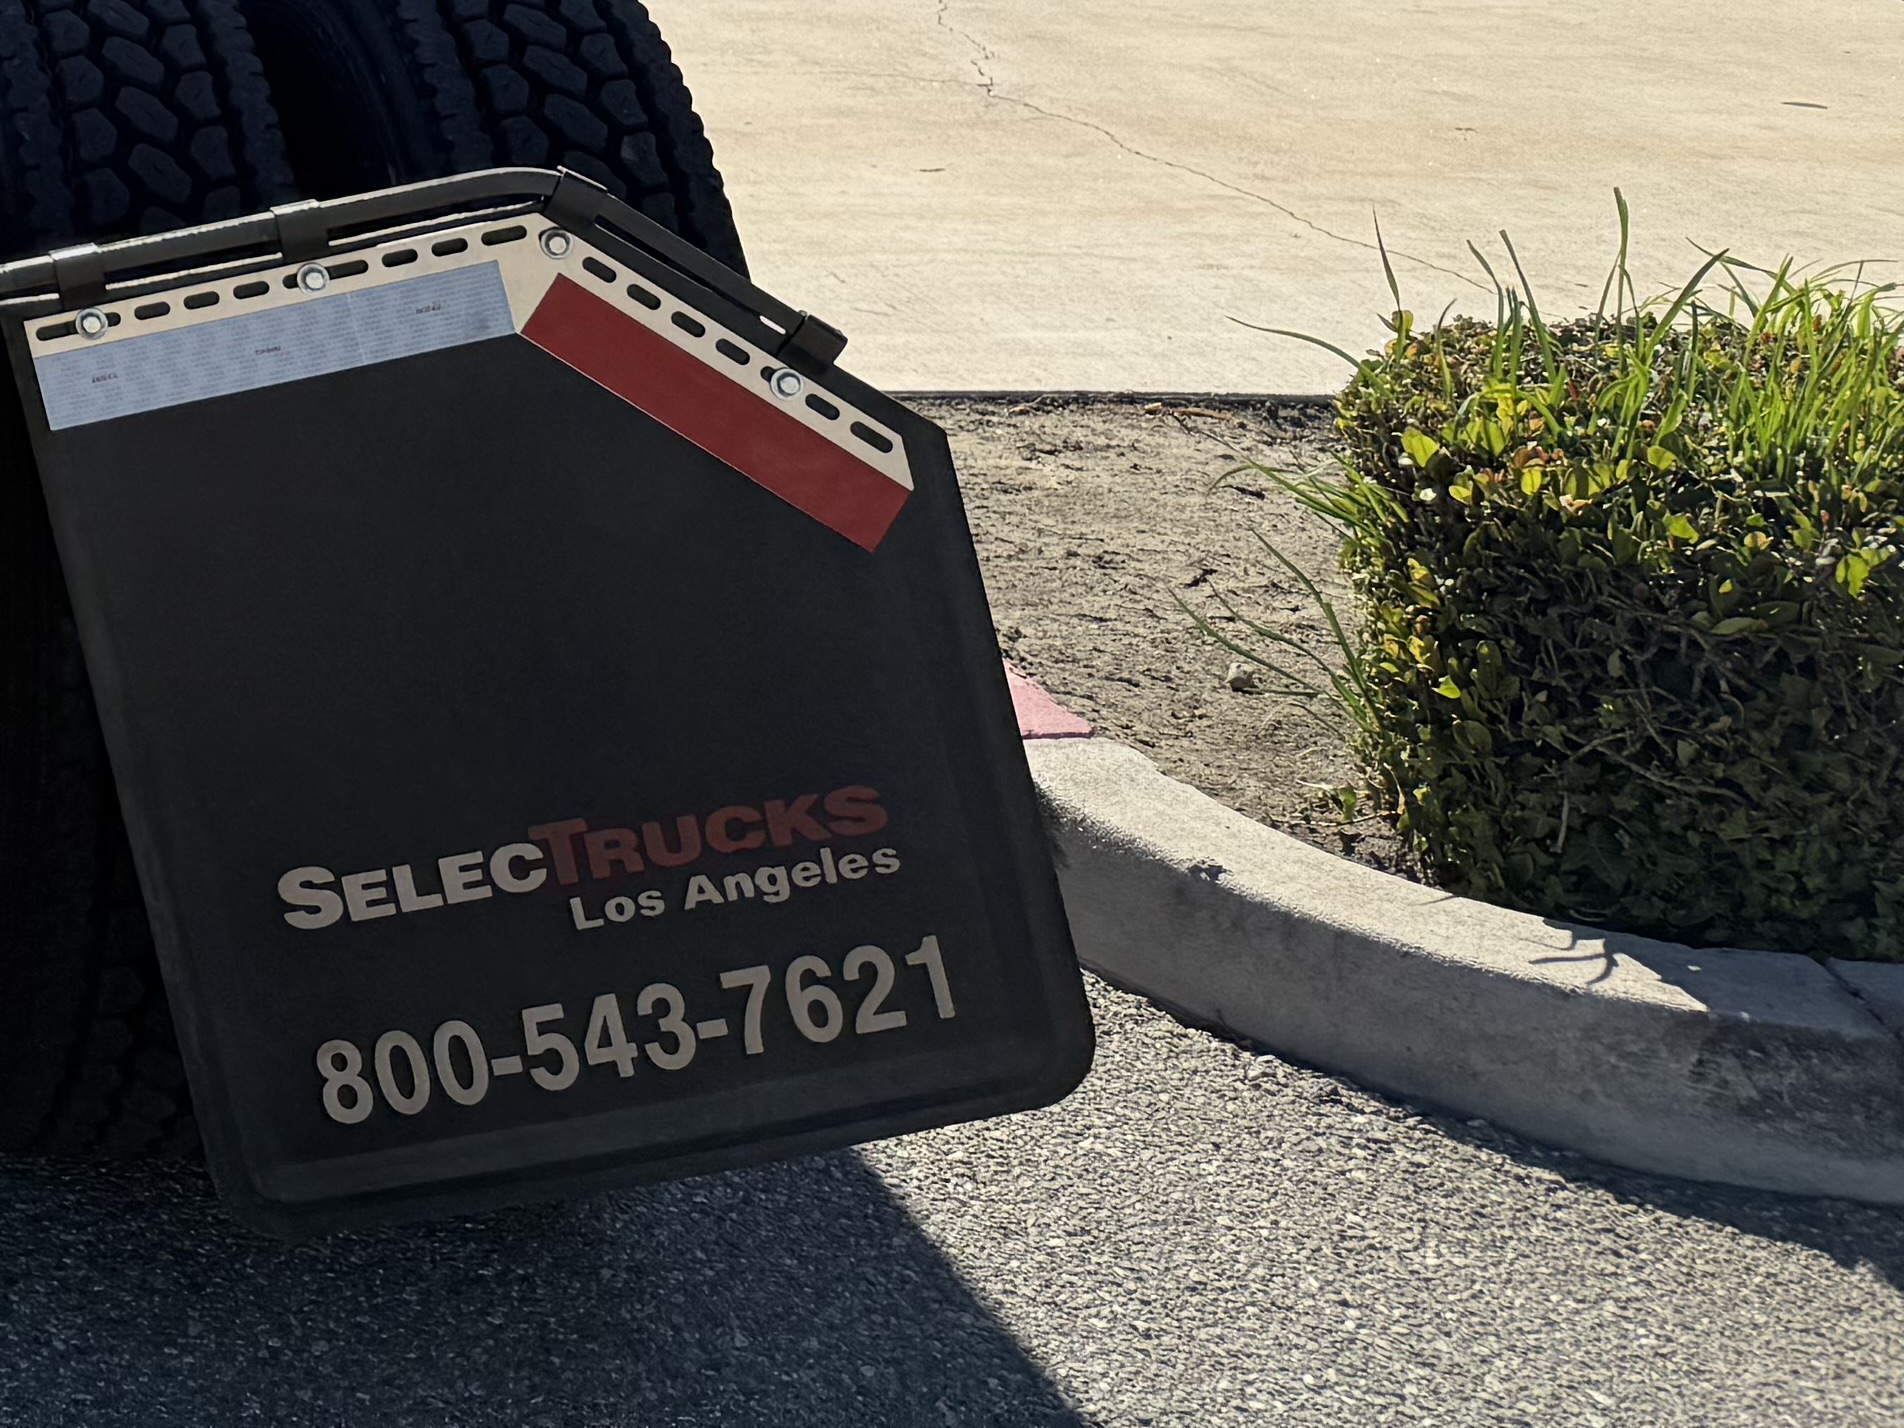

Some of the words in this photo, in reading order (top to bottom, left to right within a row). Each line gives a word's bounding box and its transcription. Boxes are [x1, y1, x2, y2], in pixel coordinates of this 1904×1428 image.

[569, 890, 665, 930] Los
[684, 847, 901, 910] Angeles
[316, 935, 956, 1124] 800-543-7621
